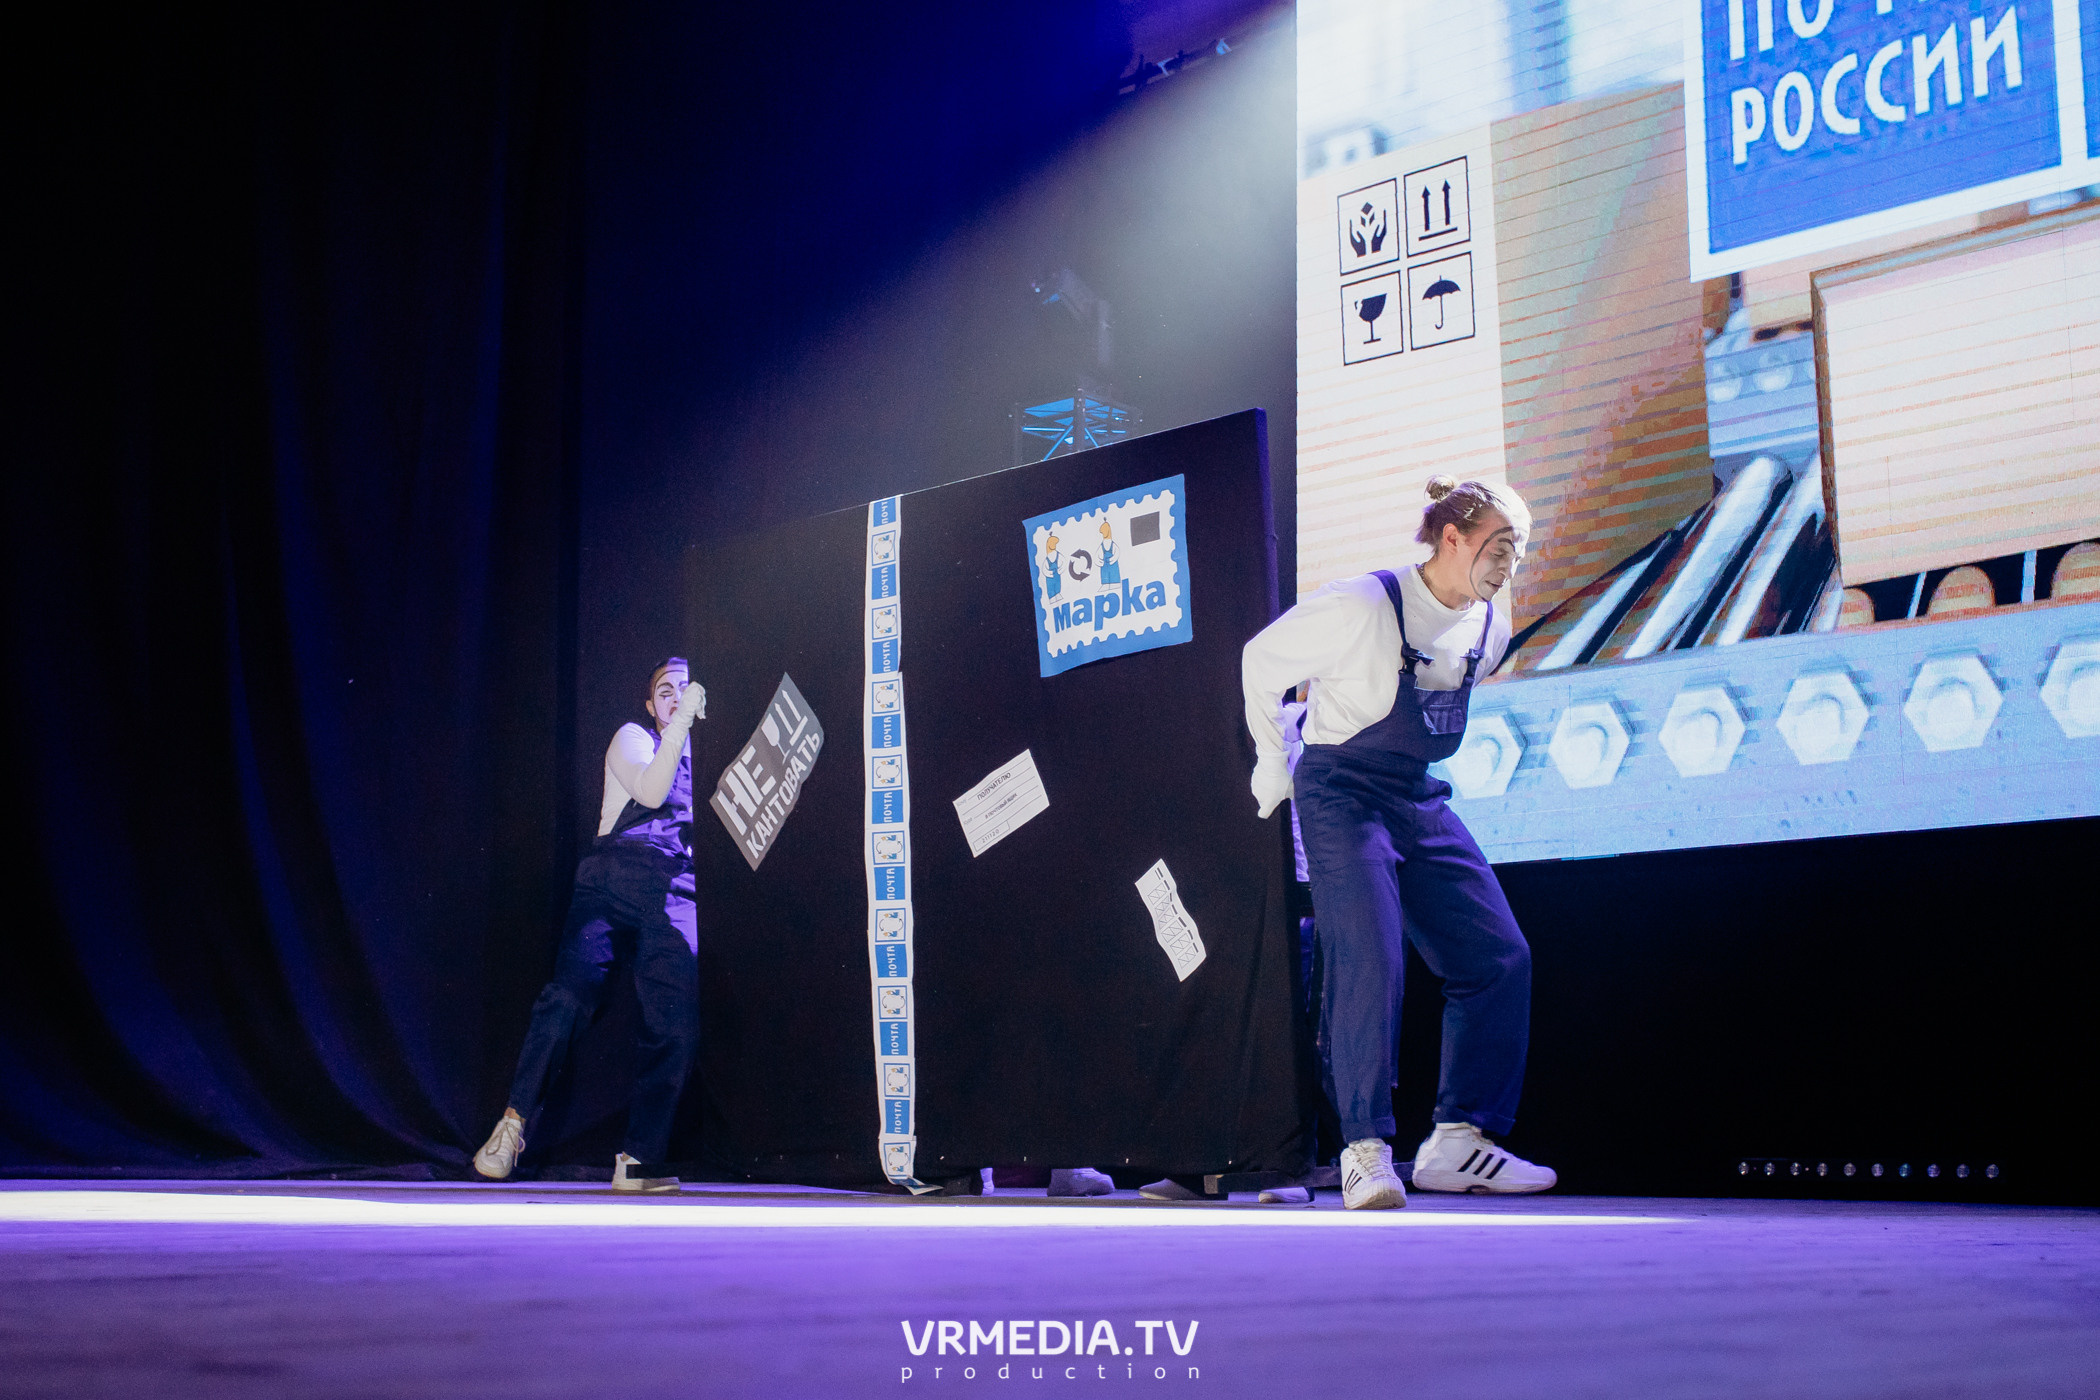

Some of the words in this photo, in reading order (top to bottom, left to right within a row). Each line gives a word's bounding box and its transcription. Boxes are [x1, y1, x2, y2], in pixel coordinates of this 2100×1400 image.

[1730, 5, 2023, 165] РОССИИ
[881, 501, 889, 525] ПОЧТ
[881, 566, 889, 598] ПОЧТА
[882, 641, 891, 672] ПОЧТА
[883, 716, 892, 748] ПОЧТА
[717, 745, 776, 836] НЕ
[746, 732, 820, 859] КАНТОВАТЬ
[977, 772, 1011, 801] ПОЛУЧАТЕЛЮ
[883, 791, 892, 823] ПОЧТА
[887, 868, 896, 899] ПОЧТА
[886, 945, 898, 977] ПОЧТА
[890, 1023, 900, 1055] ПОЧТА
[894, 1101, 903, 1133] ПОЧТА
